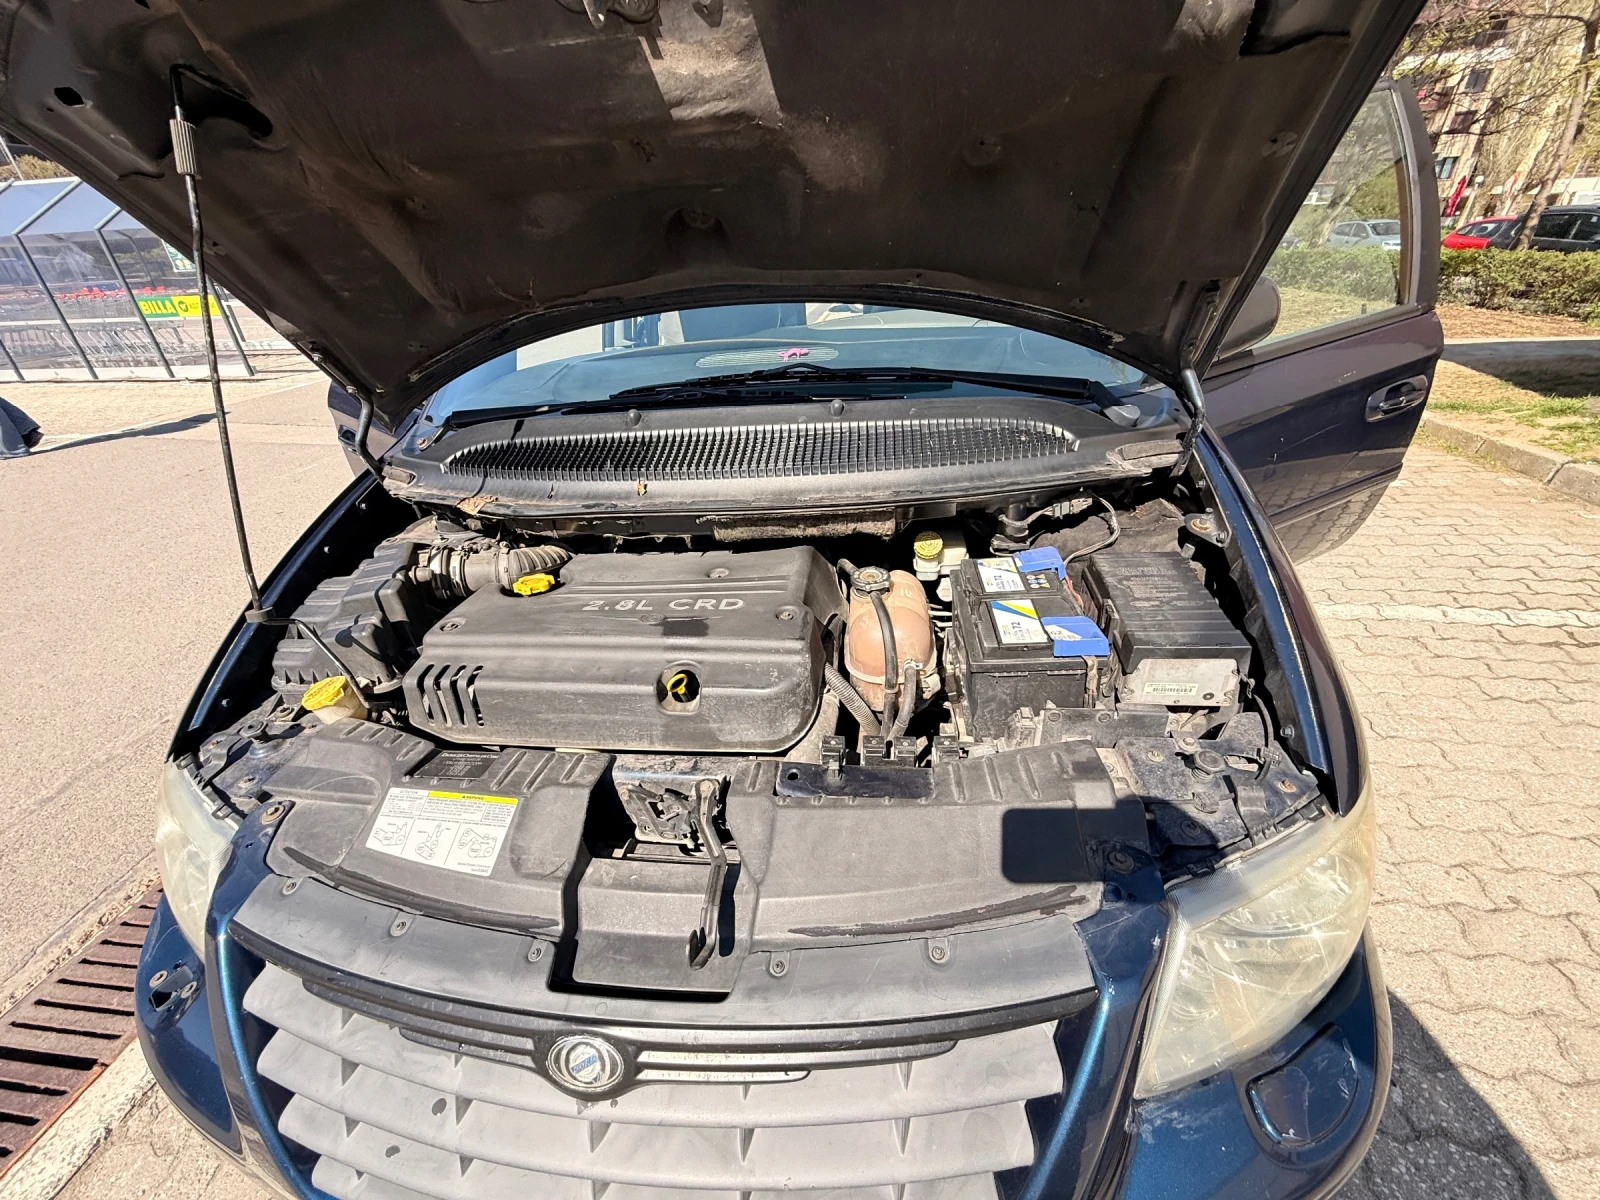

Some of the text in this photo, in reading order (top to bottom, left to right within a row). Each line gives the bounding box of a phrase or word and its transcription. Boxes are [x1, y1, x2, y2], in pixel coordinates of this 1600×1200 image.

[139, 300, 177, 314] BILLA
[582, 598, 745, 611] 2.8L CRD
